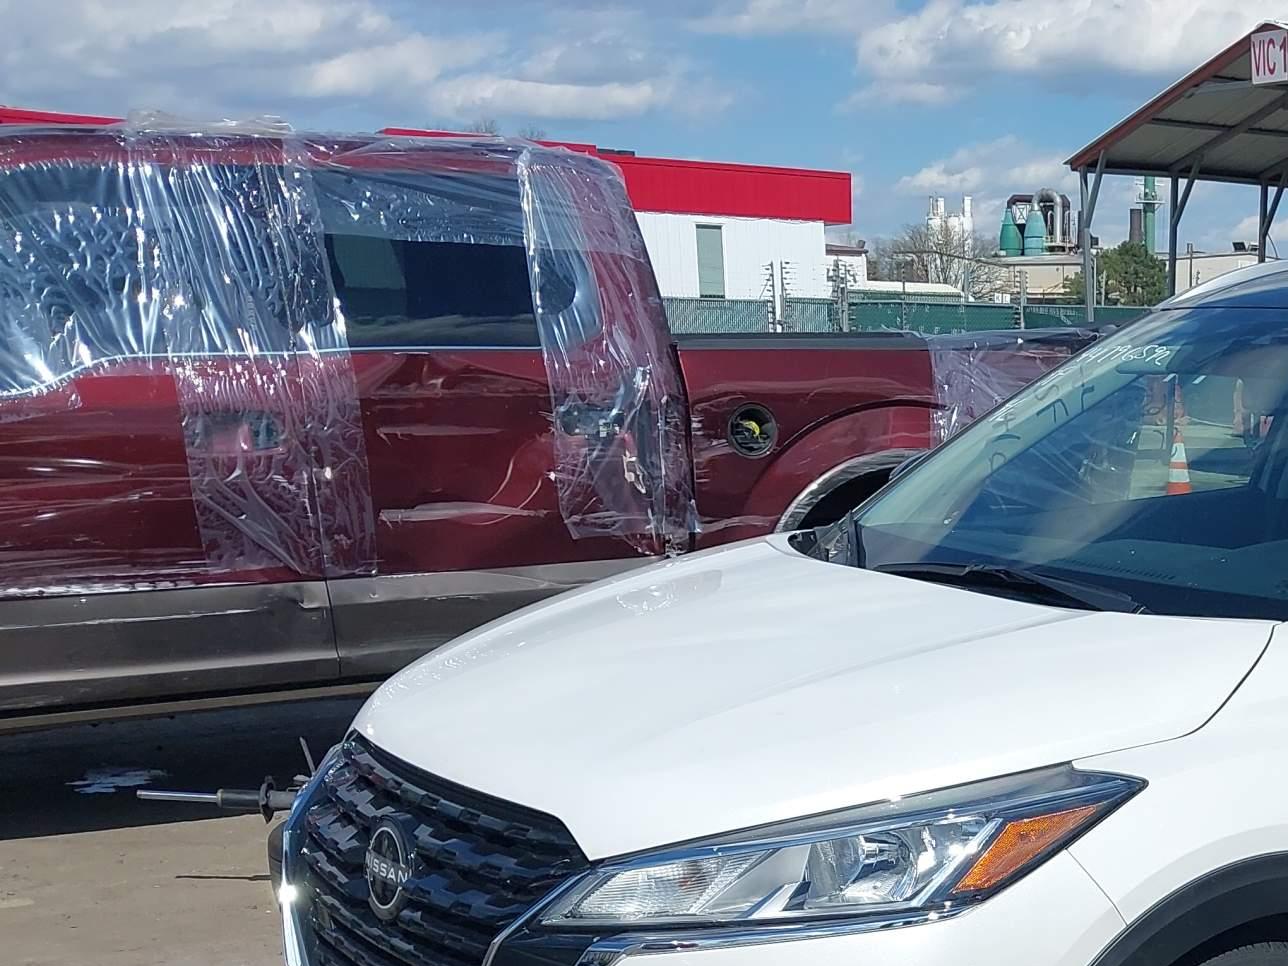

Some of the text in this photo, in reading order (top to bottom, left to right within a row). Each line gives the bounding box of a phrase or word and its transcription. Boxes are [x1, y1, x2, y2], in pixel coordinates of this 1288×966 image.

[1252, 36, 1287, 77] VIC 1
[365, 850, 408, 883] NISSAN
